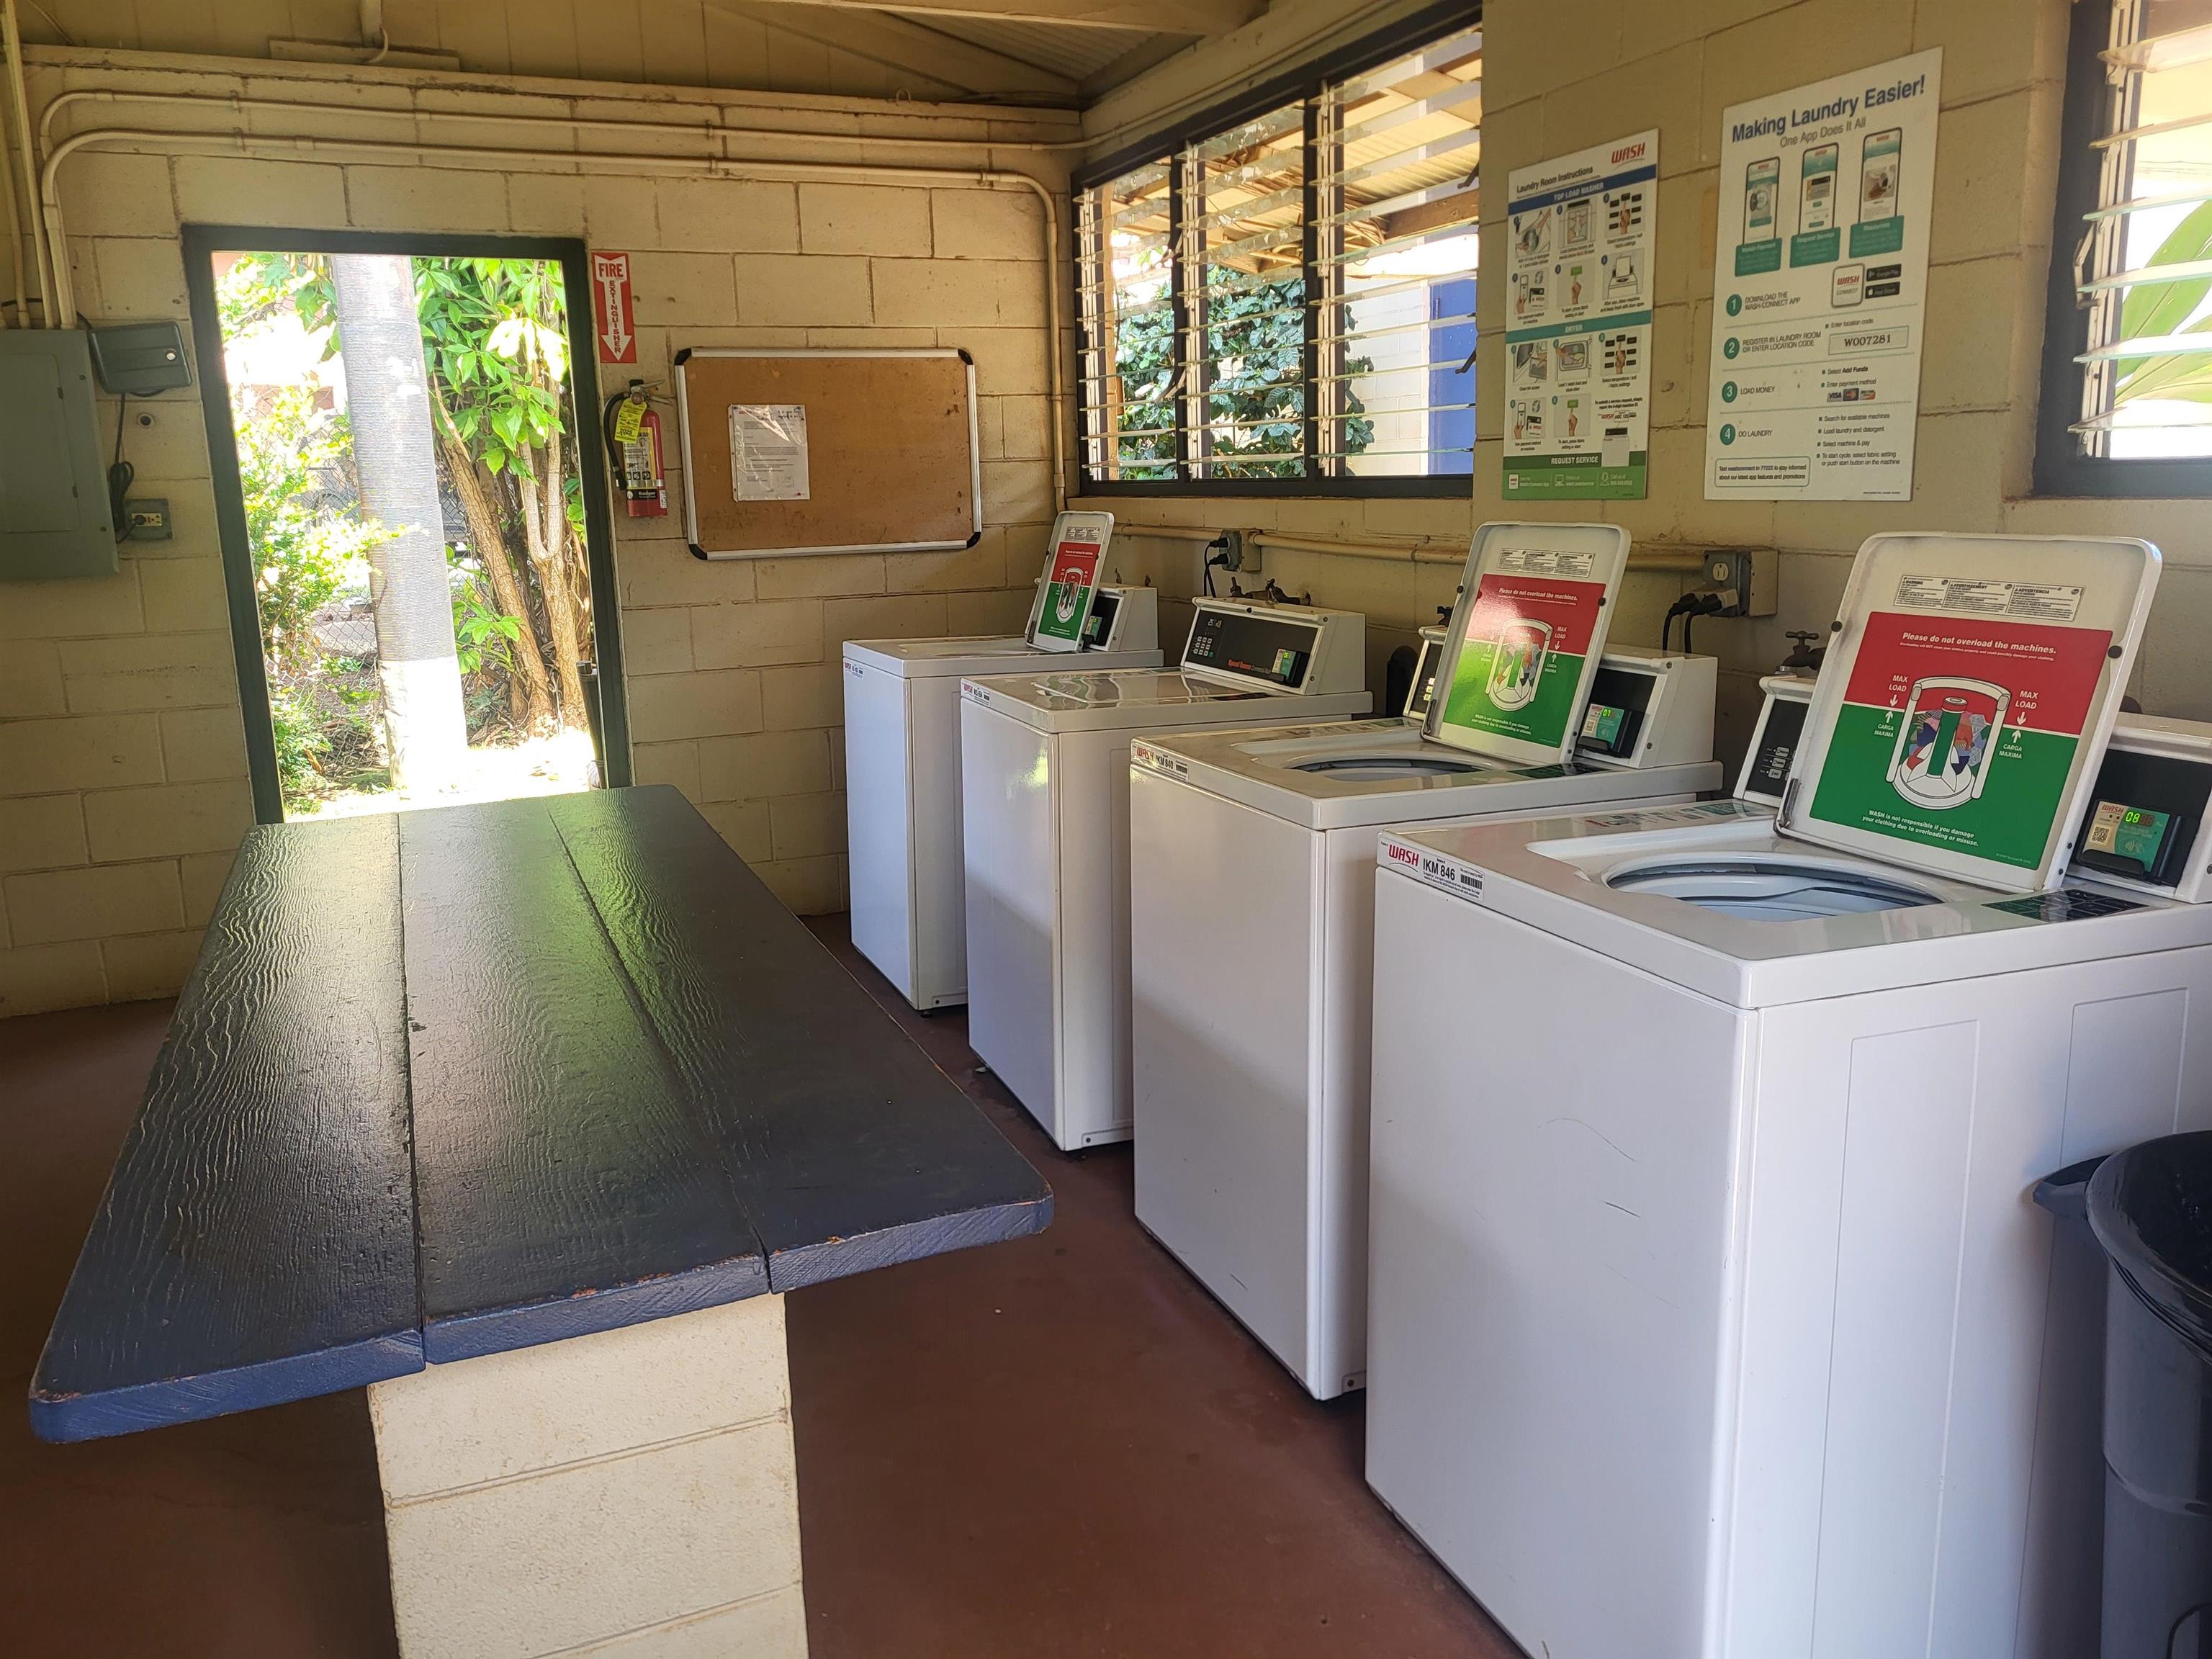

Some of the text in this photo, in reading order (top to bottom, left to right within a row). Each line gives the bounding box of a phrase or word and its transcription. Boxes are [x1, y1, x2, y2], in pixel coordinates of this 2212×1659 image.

[1732, 73, 1925, 143] Making Laundry Easier!
[1780, 116, 1866, 148] One App Does It All
[1611, 142, 1646, 164] WASH
[1516, 181, 1539, 193] Laundry
[1540, 176, 1557, 187] Room
[1558, 166, 1593, 181] Instructions
[1553, 193, 1565, 202] TOP
[1565, 188, 1581, 198] LOAD
[1581, 182, 1604, 194] WASHER
[598, 263, 624, 278] FIRE
[1837, 275, 1861, 285] WASH
[1732, 298, 1736, 310] 1
[1745, 293, 1776, 304] DOWNLOAD
[1745, 297, 1801, 310] WASH-CONNECT APP
[609, 280, 621, 354] EXTINGUISHER
[1743, 337, 1768, 346] REGISTER
[1776, 333, 1802, 343] LAUNDRY
[1803, 331, 1821, 340] ROOM
[1844, 333, 1891, 347] W007281
[1728, 341, 1735, 354] 2
[1770, 341, 1797, 351] LOCATION
[1727, 385, 1732, 397] 3
[1725, 428, 1731, 439] 4
[1551, 457, 1575, 465] REQUEST
[1902, 632, 2056, 655] Please do not overload the machines.
[1889, 683, 1907, 692] LOAD
[2019, 690, 2039, 699] MAX
[2015, 700, 2037, 709] LOAD
[1137, 746, 1154, 761] WASH
[1998, 750, 2022, 759] MAXIMA
[2102, 804, 2124, 814] WASH
[2125, 811, 2141, 823] 08
[1869, 809, 1885, 819] WASH
[1901, 817, 1933, 830] responsible
[1951, 828, 1974, 839] damage
[1875, 818, 1897, 828] clothing
[1915, 827, 1948, 840] overloading
[1956, 836, 1979, 847] misuse.
[1389, 844, 1455, 881] WASH IKM 846
